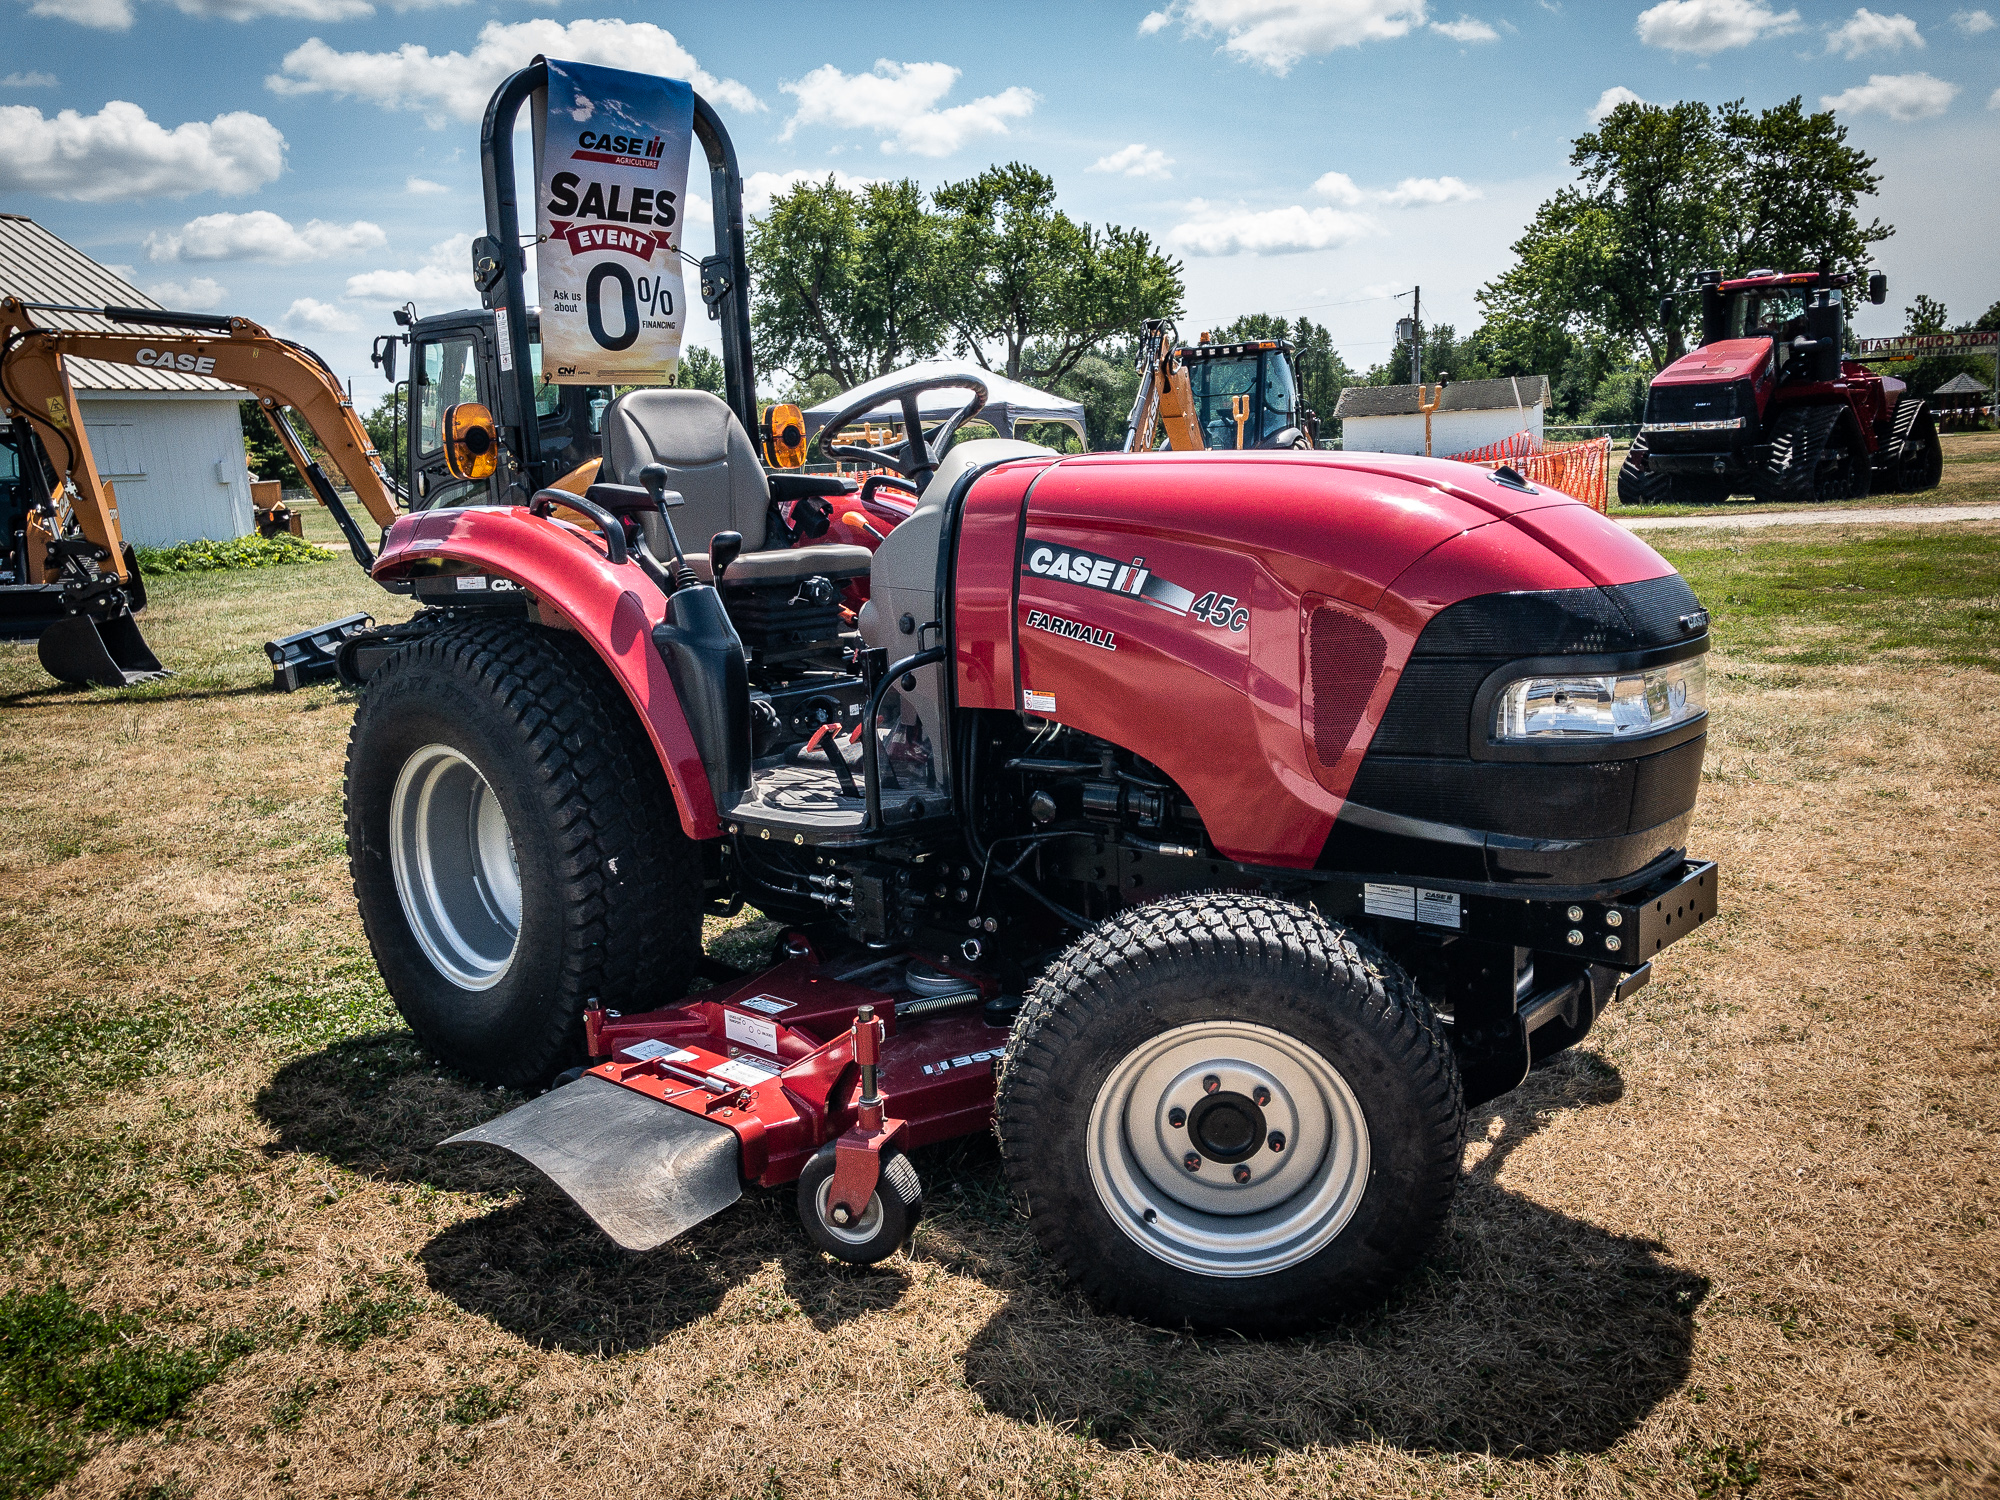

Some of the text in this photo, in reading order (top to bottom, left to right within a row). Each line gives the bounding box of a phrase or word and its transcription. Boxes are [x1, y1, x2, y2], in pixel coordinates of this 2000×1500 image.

[578, 130, 644, 156] CASE
[615, 157, 658, 168] AGRICULTURE
[546, 171, 677, 227] SALES
[577, 229, 647, 252] EVENT
[553, 289, 582, 301] Ask us
[554, 302, 578, 313] about
[642, 320, 676, 330] FINANCING
[136, 348, 216, 375] CASE
[557, 365, 576, 375] CNH
[1145, 386, 1160, 449] CASE
[1029, 547, 1116, 589] CASE
[1026, 610, 1116, 651] FARMALL
[1687, 611, 1707, 629] CASE
[1425, 892, 1446, 900] CASE
[951, 1047, 1008, 1068] ASE
